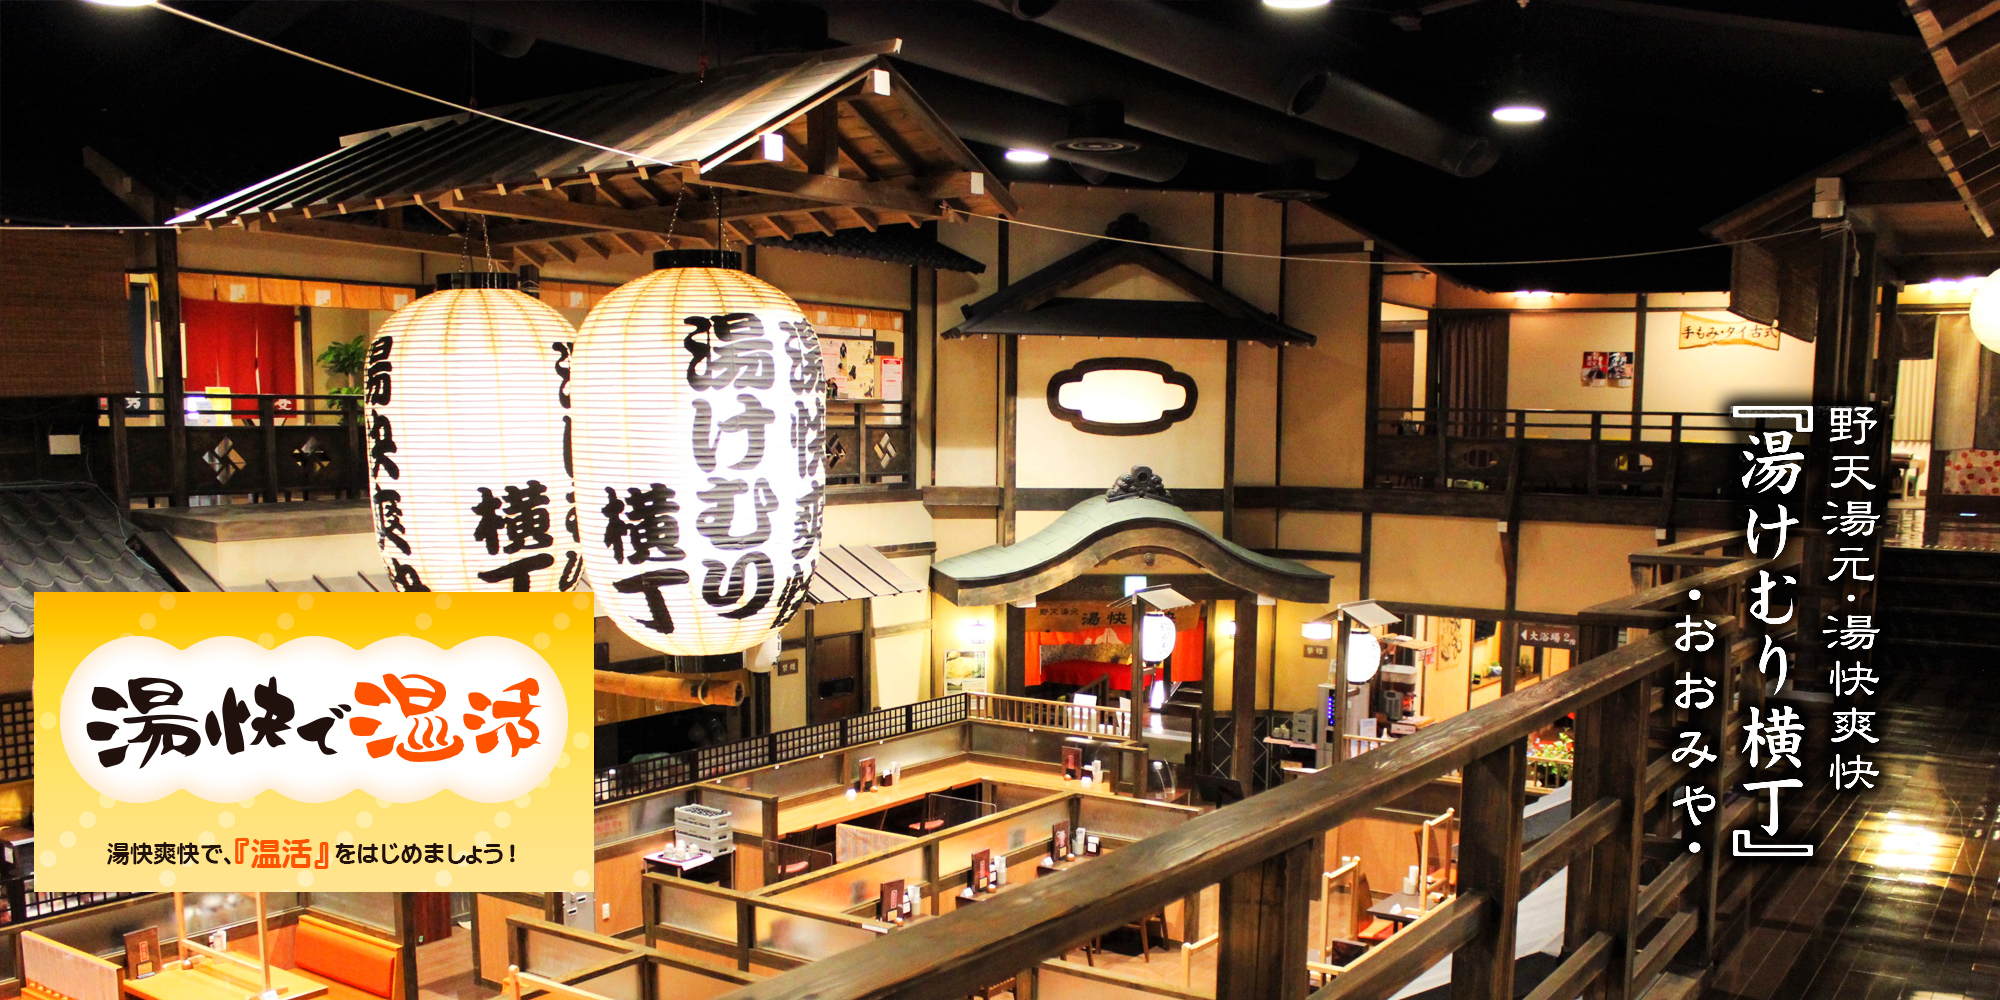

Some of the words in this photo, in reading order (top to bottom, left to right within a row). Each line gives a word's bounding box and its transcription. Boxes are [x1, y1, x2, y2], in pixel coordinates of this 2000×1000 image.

[601, 483, 691, 635] 横丁
[683, 313, 780, 620] 湯けむり
